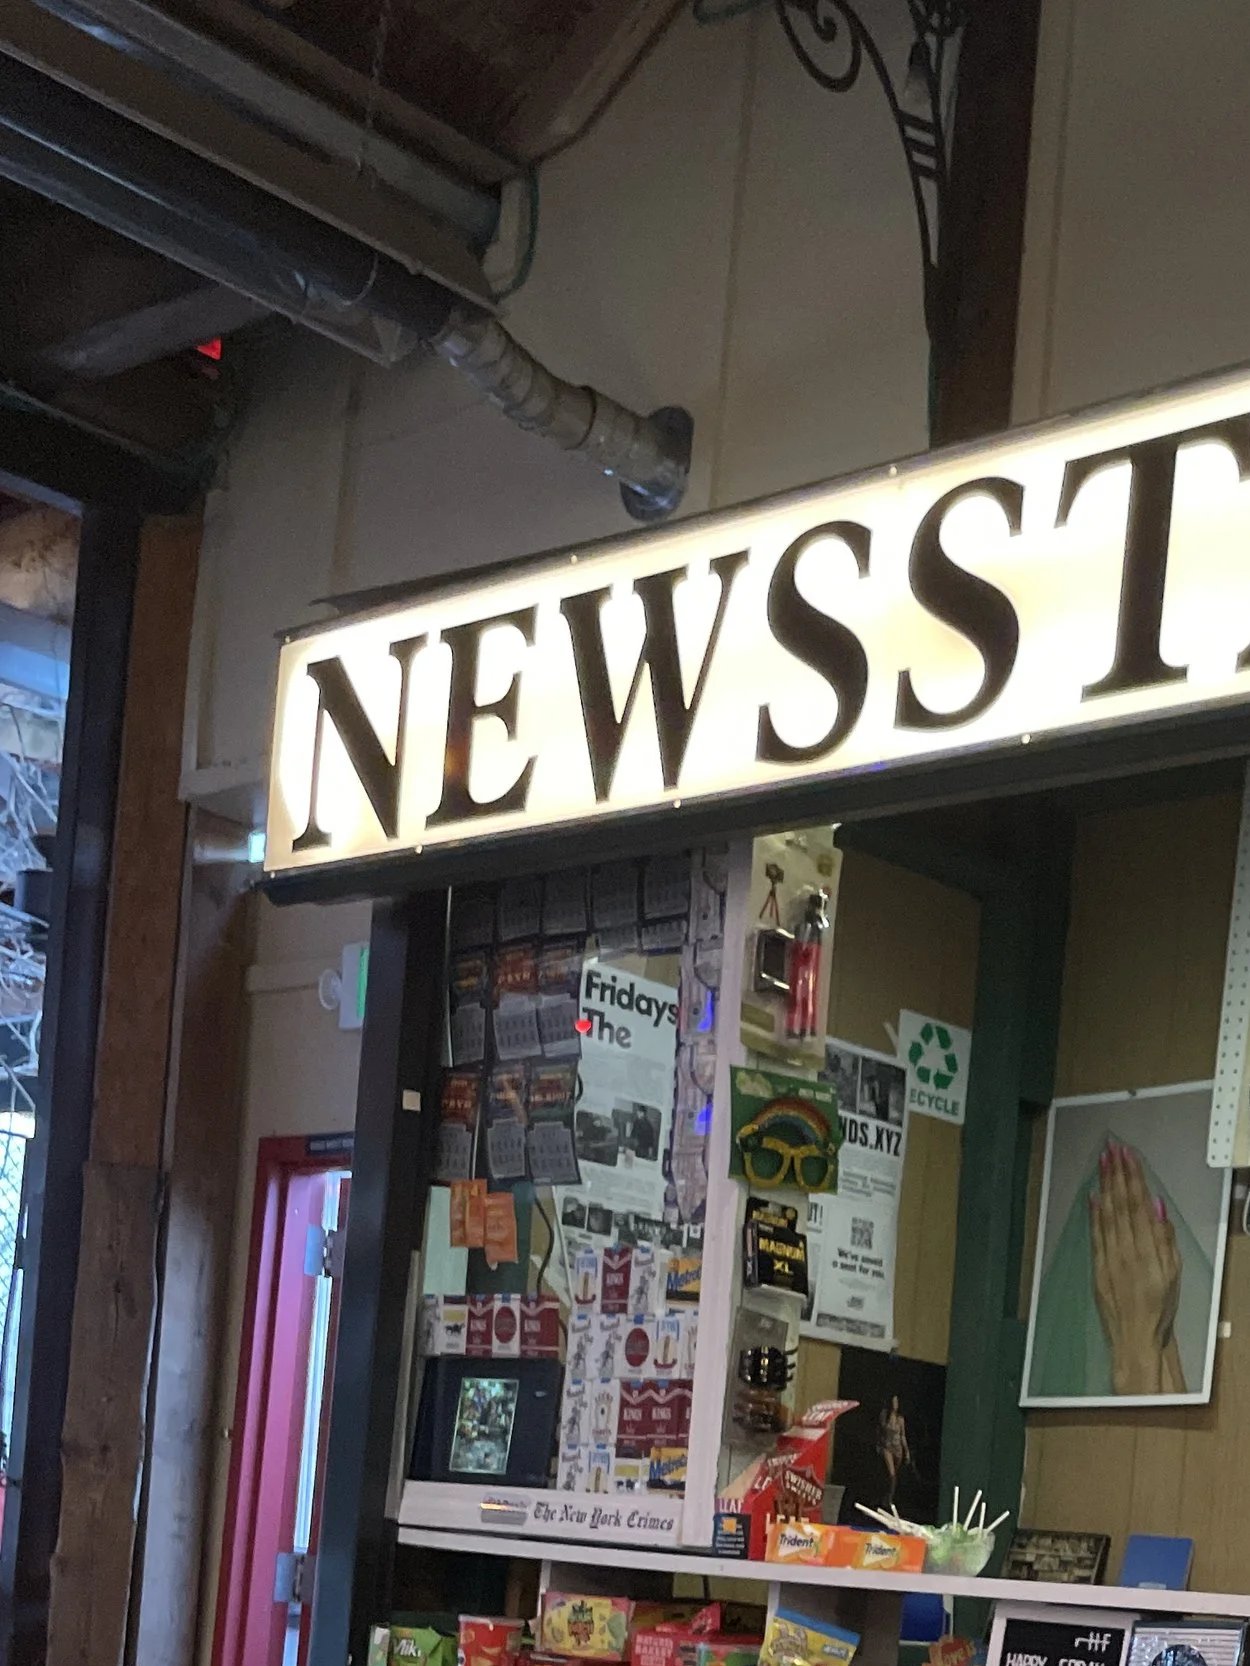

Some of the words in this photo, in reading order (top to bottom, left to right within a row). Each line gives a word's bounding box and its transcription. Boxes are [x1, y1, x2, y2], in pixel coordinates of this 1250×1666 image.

[585, 969, 679, 1028] Fridays
[582, 1006, 632, 1049] The
[909, 1088, 960, 1116] ECYCLE
[859, 1263, 870, 1276] for
[785, 1469, 824, 1501] SWISHER
[533, 1501, 557, 1523] The
[559, 1504, 588, 1525] New
[589, 1506, 623, 1530] York
[626, 1508, 675, 1532] Crimes
[778, 1533, 816, 1549] Trident
[865, 1541, 898, 1556] Trident
